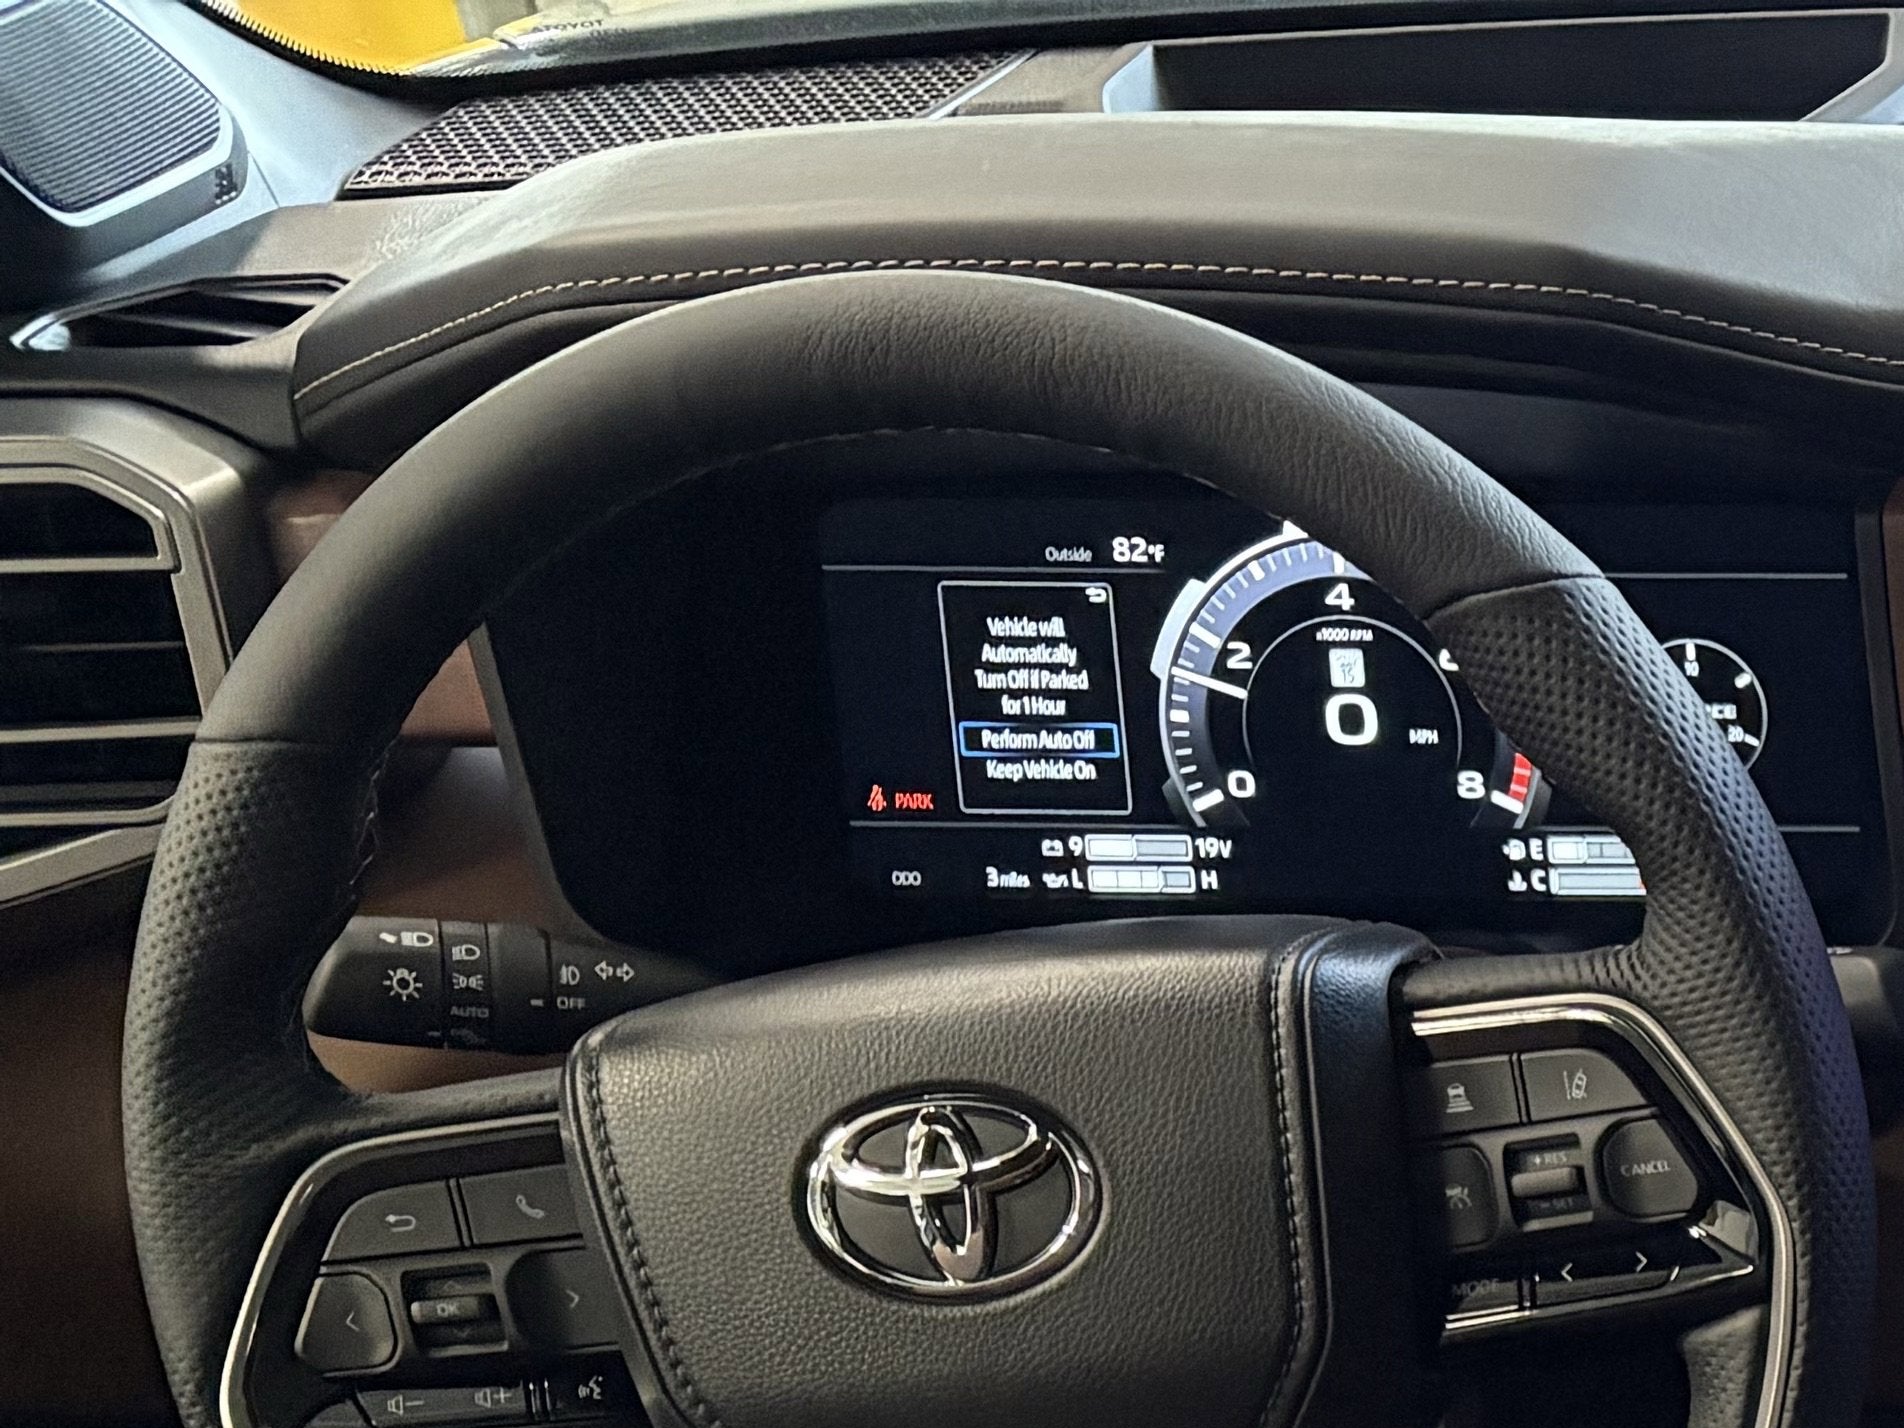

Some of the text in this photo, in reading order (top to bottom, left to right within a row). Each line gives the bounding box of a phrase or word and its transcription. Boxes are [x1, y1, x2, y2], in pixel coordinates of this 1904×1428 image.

[1045, 546, 1092, 562] Outside
[1325, 583, 1355, 610] 4
[987, 617, 1065, 637] Vehicle will
[981, 644, 1077, 666] Automatically
[1226, 642, 1253, 669] 2
[975, 670, 1005, 689] Turn
[1006, 670, 1029, 689] Off
[1039, 670, 1089, 690] Parked
[1001, 697, 1021, 716] for
[1031, 697, 1066, 716] Hour
[1325, 694, 1439, 745] 0 MPH
[981, 729, 1095, 750] Perform Auto Off
[986, 761, 1096, 782] Keep Vehicle On
[1227, 770, 1485, 799] 0 8
[895, 792, 934, 811] PARK
[1068, 838, 1084, 857] 9
[986, 868, 998, 888] 3
[1071, 869, 1218, 890] L H
[1531, 870, 1546, 891] C
[450, 1005, 490, 1019] AUTO
[556, 998, 586, 1011] OFF
[1620, 1159, 1672, 1178] CANCEL
[436, 1303, 460, 1317] OK
